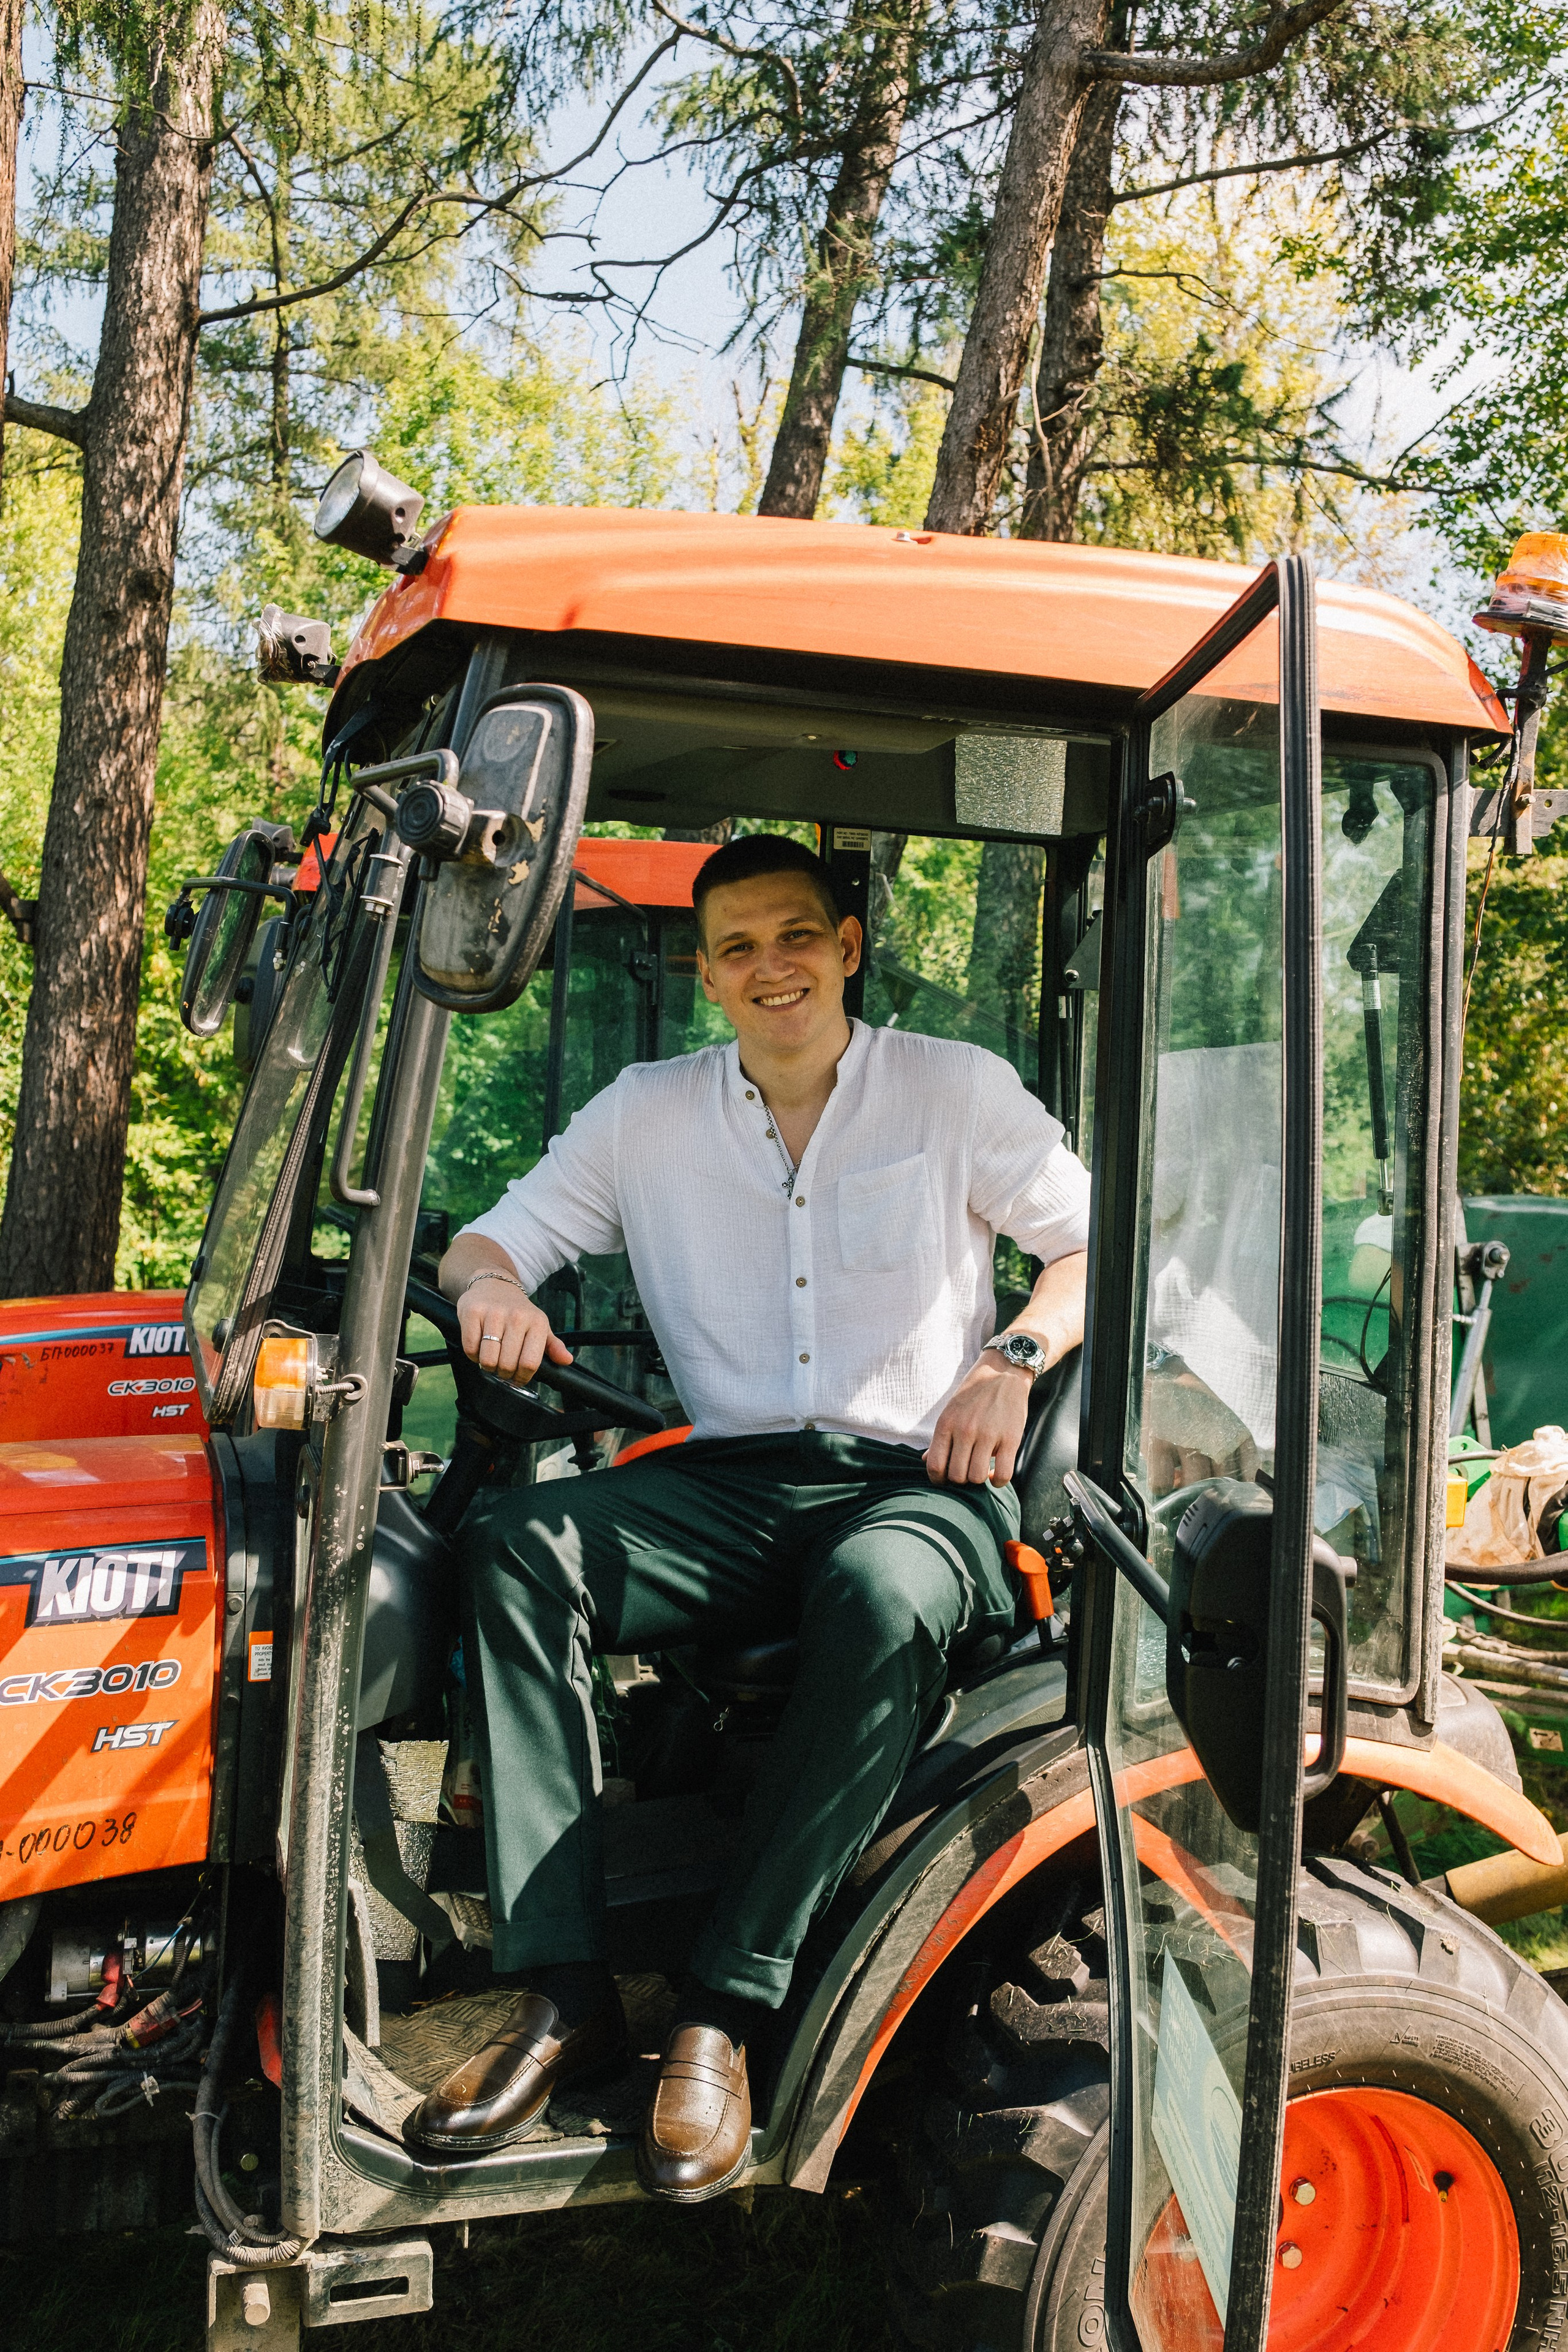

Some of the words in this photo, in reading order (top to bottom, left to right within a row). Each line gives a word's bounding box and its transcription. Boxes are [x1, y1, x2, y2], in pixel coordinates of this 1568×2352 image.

[129, 1325, 190, 1354] KIOT
[108, 1378, 196, 1396] CK3010
[152, 1404, 190, 1419] HST
[37, 1550, 176, 1618] KIOTI
[0, 1659, 181, 1705] CK3010
[91, 1721, 178, 1752] HST
